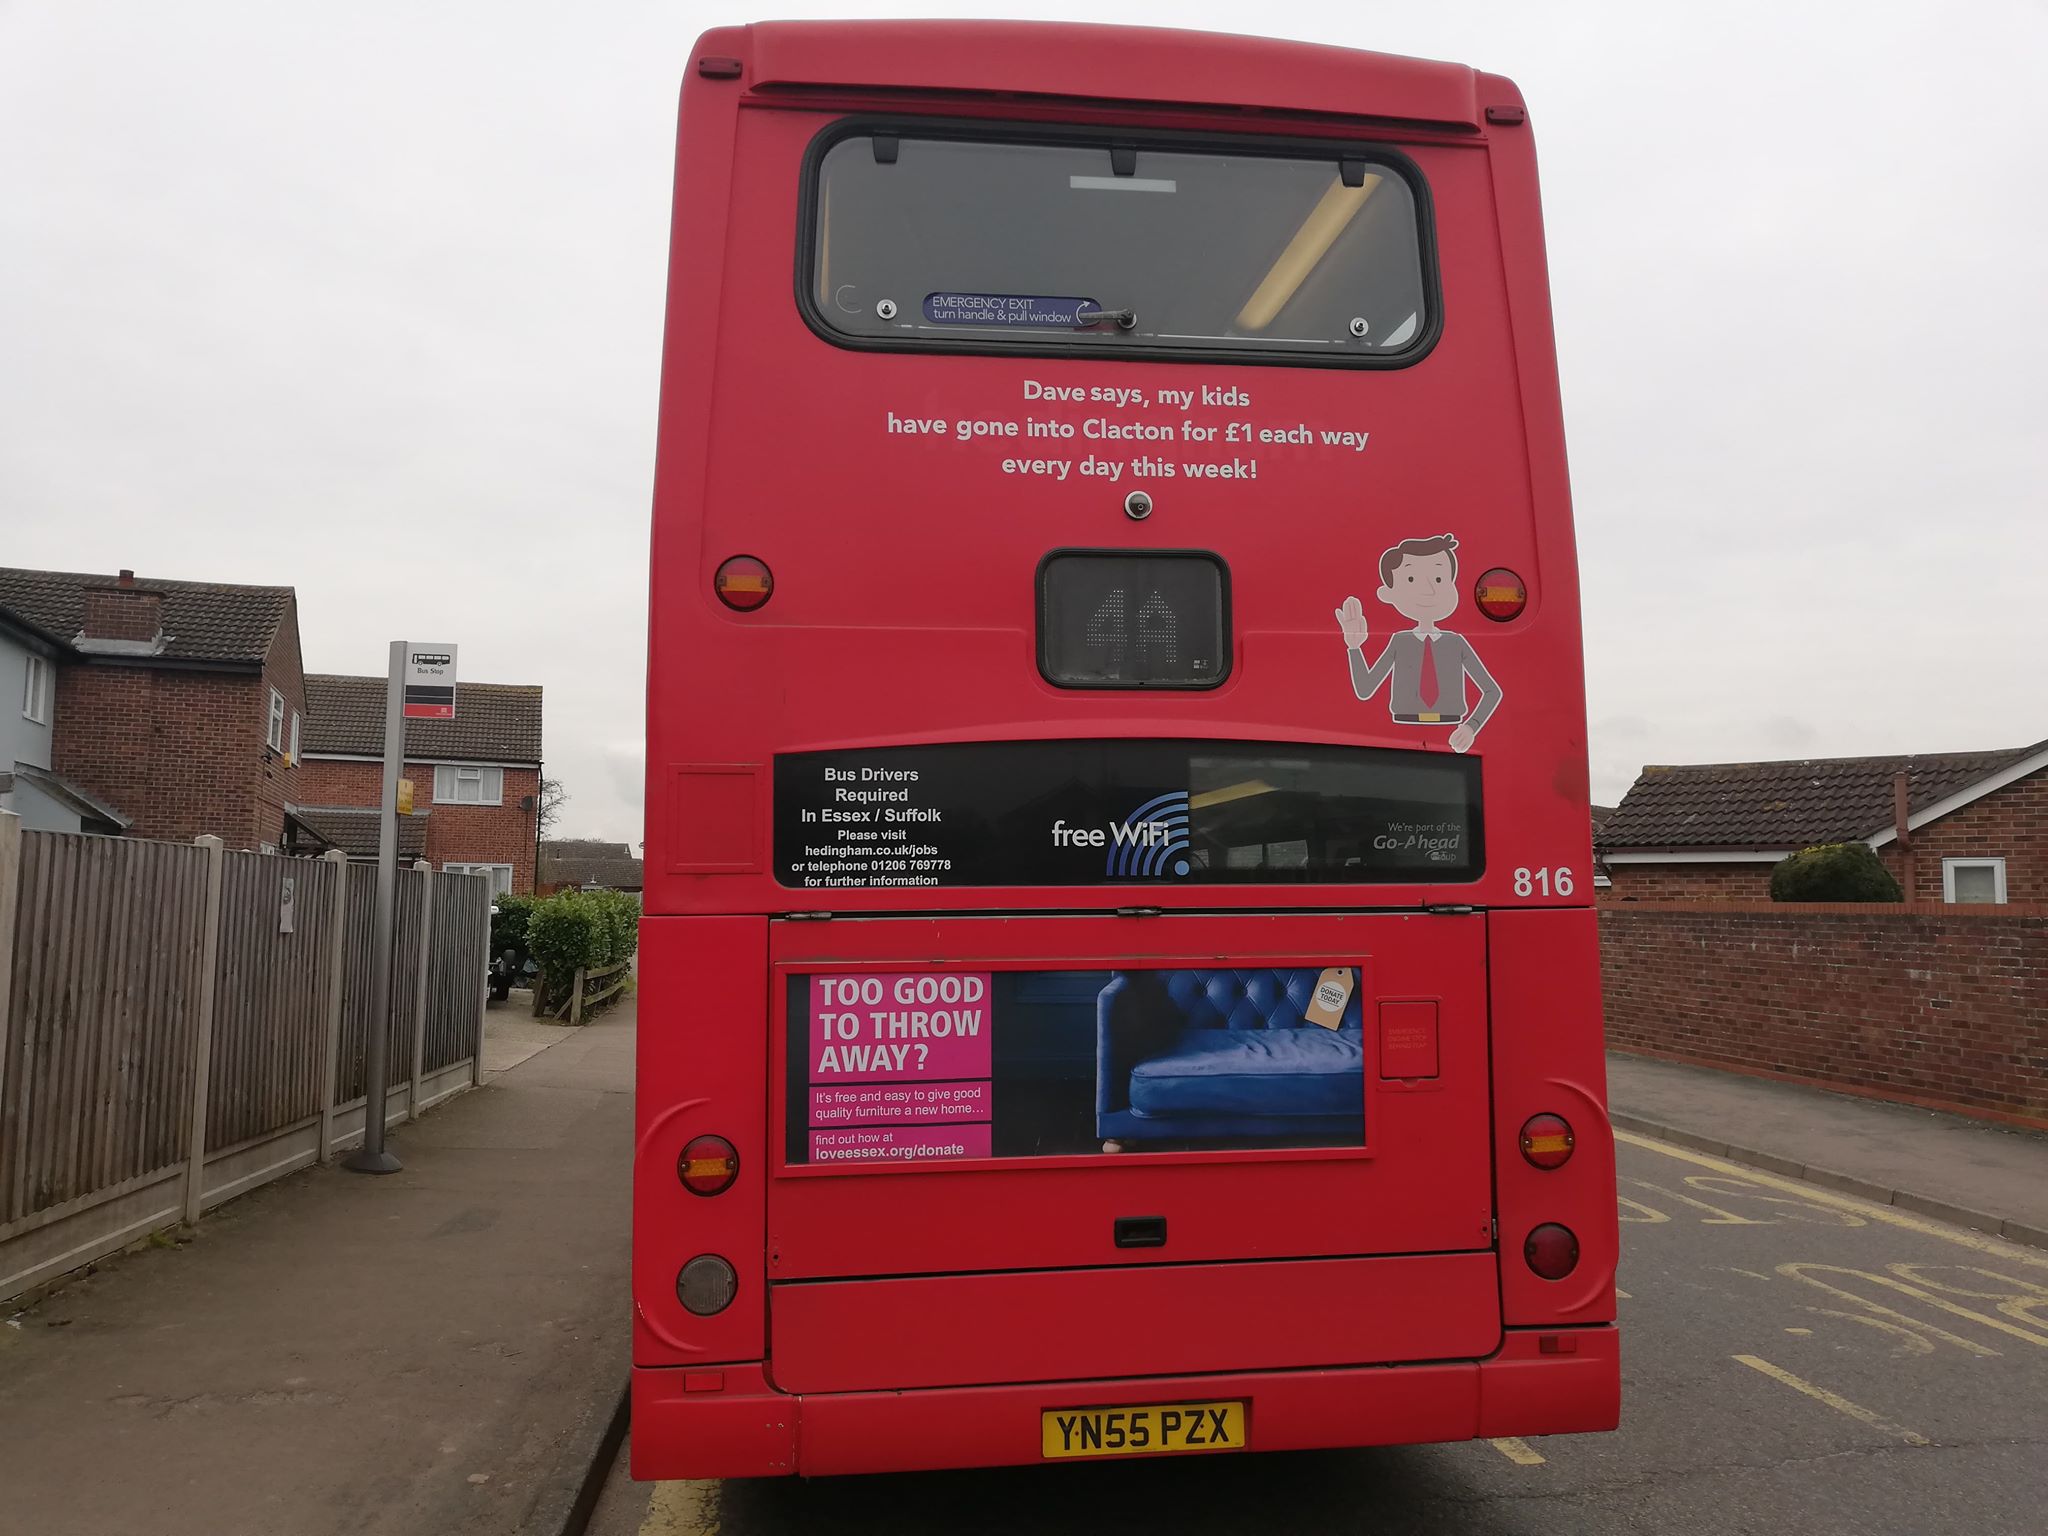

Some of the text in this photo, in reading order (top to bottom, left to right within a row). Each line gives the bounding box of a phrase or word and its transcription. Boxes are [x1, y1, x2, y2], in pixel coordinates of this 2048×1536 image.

[932, 296, 1034, 310] EMERGENCY EXIT
[933, 309, 1071, 324] turn handle & pull window
[1023, 380, 1250, 410] Dave says, my kids
[887, 412, 1369, 451] have gone into Clacton for £1 each way
[1001, 454, 1257, 482] every day this week!
[1086, 590, 1177, 663] 4A
[824, 767, 919, 781] Bus Drivers
[835, 788, 909, 805] Required
[801, 808, 942, 822] In Essex / Suffolk
[837, 829, 907, 841] Please visit
[1051, 820, 1169, 847] free WiFi
[1387, 822, 1461, 834] We're part of the
[1373, 834, 1460, 850] Go-Ahead
[805, 844, 938, 858] hedingham.co.uk/jobs
[791, 859, 951, 874] or telephone 01206 769778
[804, 875, 938, 887] for further information
[1513, 866, 1574, 897] 816
[818, 976, 985, 1006] TOO GOOD
[1320, 987, 1344, 1001] DONATE
[1320, 993, 1340, 1005] TODAY
[818, 1009, 982, 1041] TO THROW
[817, 1043, 929, 1073] AWAY?
[816, 1087, 981, 1104] It's free and easy to give good
[815, 1107, 852, 1120] quality
[855, 1105, 901, 1117] furniture
[904, 1107, 912, 1116] a
[915, 1105, 938, 1115] new
[815, 1133, 893, 1146] find out how at
[815, 1144, 964, 1161] loveessex.org/donate
[1057, 1408, 1230, 1451] YN55 PZX
